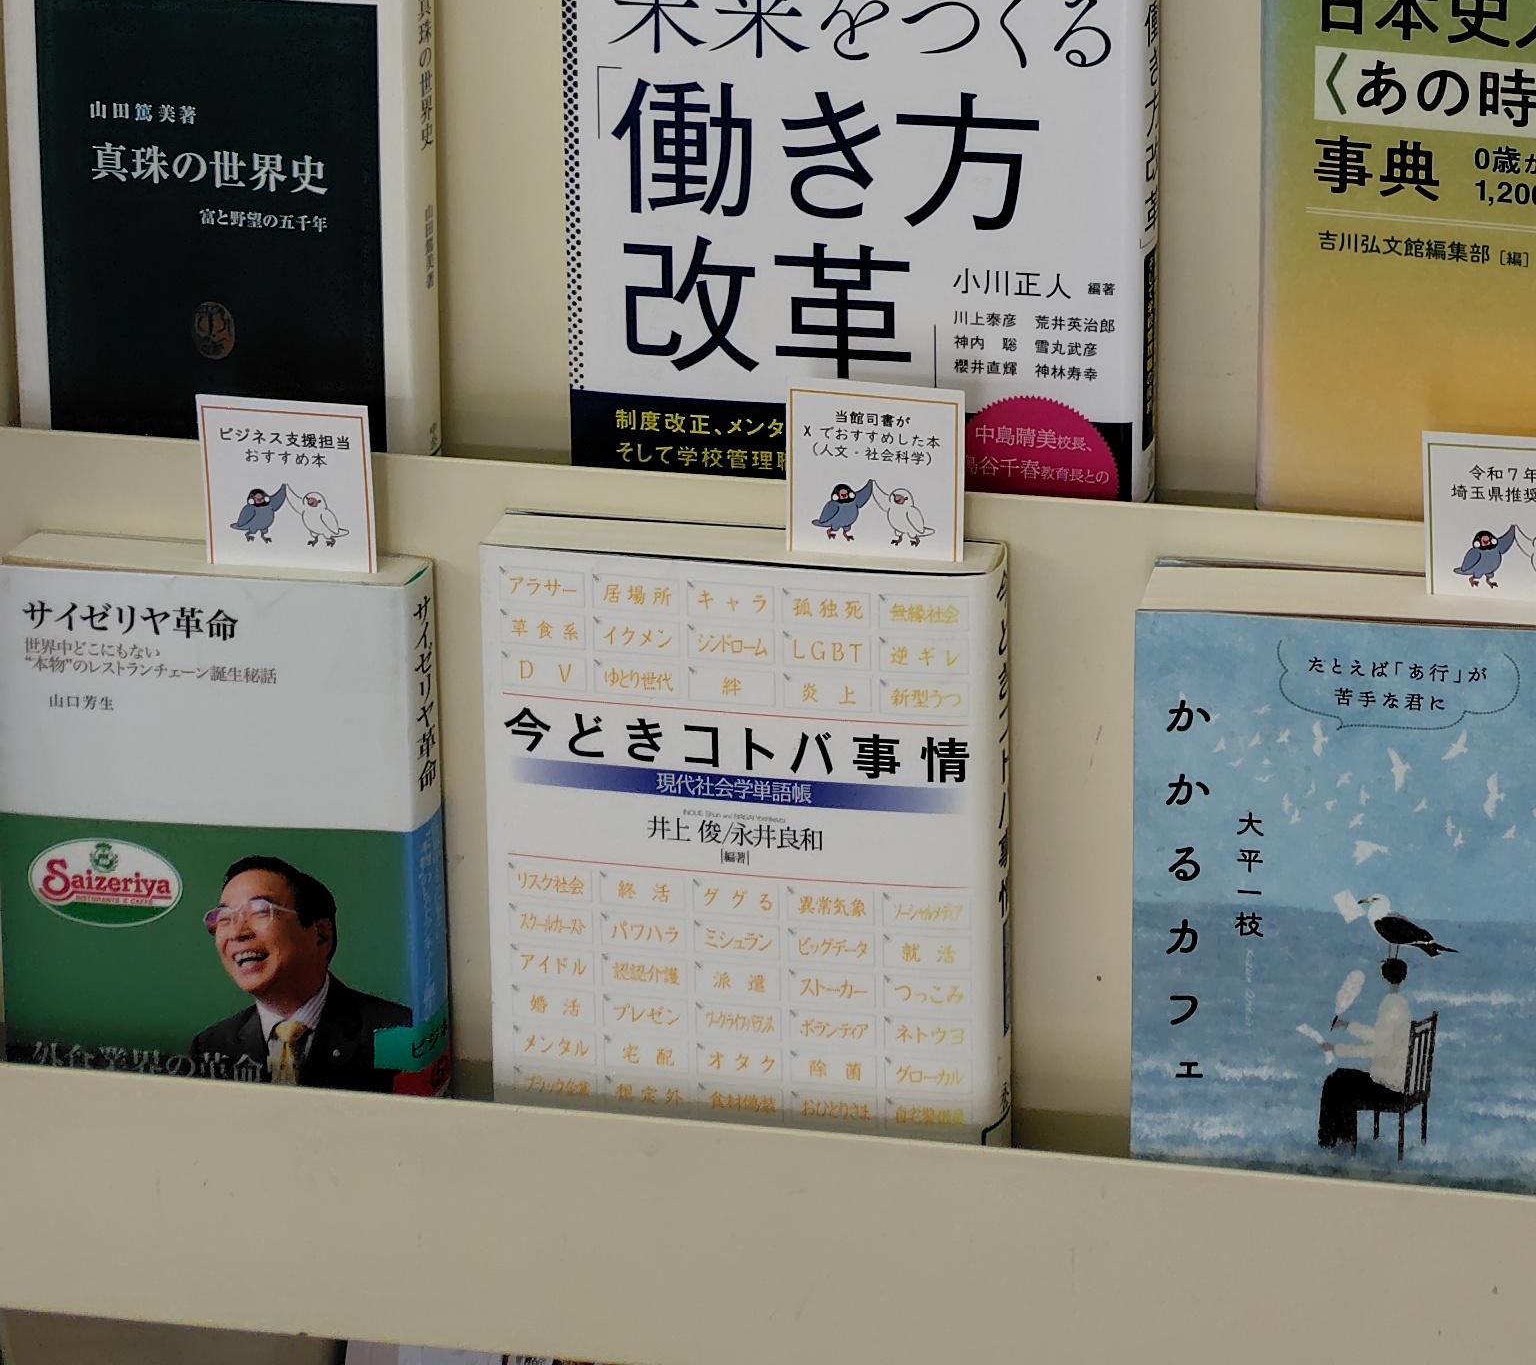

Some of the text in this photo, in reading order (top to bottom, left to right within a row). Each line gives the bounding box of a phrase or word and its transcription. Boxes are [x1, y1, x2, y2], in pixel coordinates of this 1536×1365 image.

[89, 100, 197, 125] 山田篤美著
[91, 141, 329, 195] 真珠の世界史
[1313, 135, 1441, 202] 事典
[199, 208, 328, 233] 富と野望の五千年
[1318, 229, 1491, 265] 吉川弘文館編集部
[952, 266, 1116, 301] 小川正人 編著
[622, 235, 913, 380] 改革
[952, 310, 1116, 334] 川上泰彦 荒井英治郎
[953, 333, 985, 351] 神内
[1034, 338, 1098, 357] 雪丸武彦
[1034, 362, 1098, 382] 神林寿幸
[835, 410, 911, 428] 当館司書が
[219, 427, 351, 450] ビジネス支援担当
[803, 426, 941, 449] X でおすすめした本
[245, 448, 328, 468] おすすめ本
[509, 575, 577, 598] アラサー
[603, 582, 673, 607] 居場所
[697, 587, 769, 614] キャラ
[792, 597, 864, 622] 孤独死
[22, 599, 239, 641] サイゼリヤ革命
[510, 618, 579, 642] 草食系
[24, 636, 161, 659] 世界中どこにもない
[603, 625, 673, 649] イクメン
[793, 638, 863, 664] LGBT
[890, 645, 960, 669] 逆ギレ
[603, 667, 674, 694] ゆとり世代
[1308, 654, 1488, 684] たとえば「あ行」が
[721, 676, 741, 696] 絆
[802, 683, 857, 706] 炎上
[890, 686, 962, 710] 新型うつ
[1334, 687, 1446, 712] 苦手な君に
[504, 706, 970, 783] 今どきコトバ事情
[656, 771, 812, 804] 現代社会学単語帳
[40, 859, 172, 899] Saizeriya
[517, 871, 584, 896] リスク社会
[1234, 811, 1265, 939] 大平一枝
[703, 886, 773, 912] ググる
[1165, 698, 1212, 1080] かかるカフェ
[797, 895, 867, 919] 異常気象
[611, 919, 680, 944] パワハラ
[703, 925, 773, 953] ミシュラン
[798, 937, 869, 960] ビッグデータ
[519, 953, 587, 976] アイドル
[895, 982, 964, 1006] つっこみ
[613, 1002, 681, 1025] プレゼン
[523, 1032, 589, 1057] メンタル
[895, 1023, 964, 1046] ネトウヨ
[622, 1041, 675, 1067] 宅配
[708, 1049, 775, 1074] オタク
